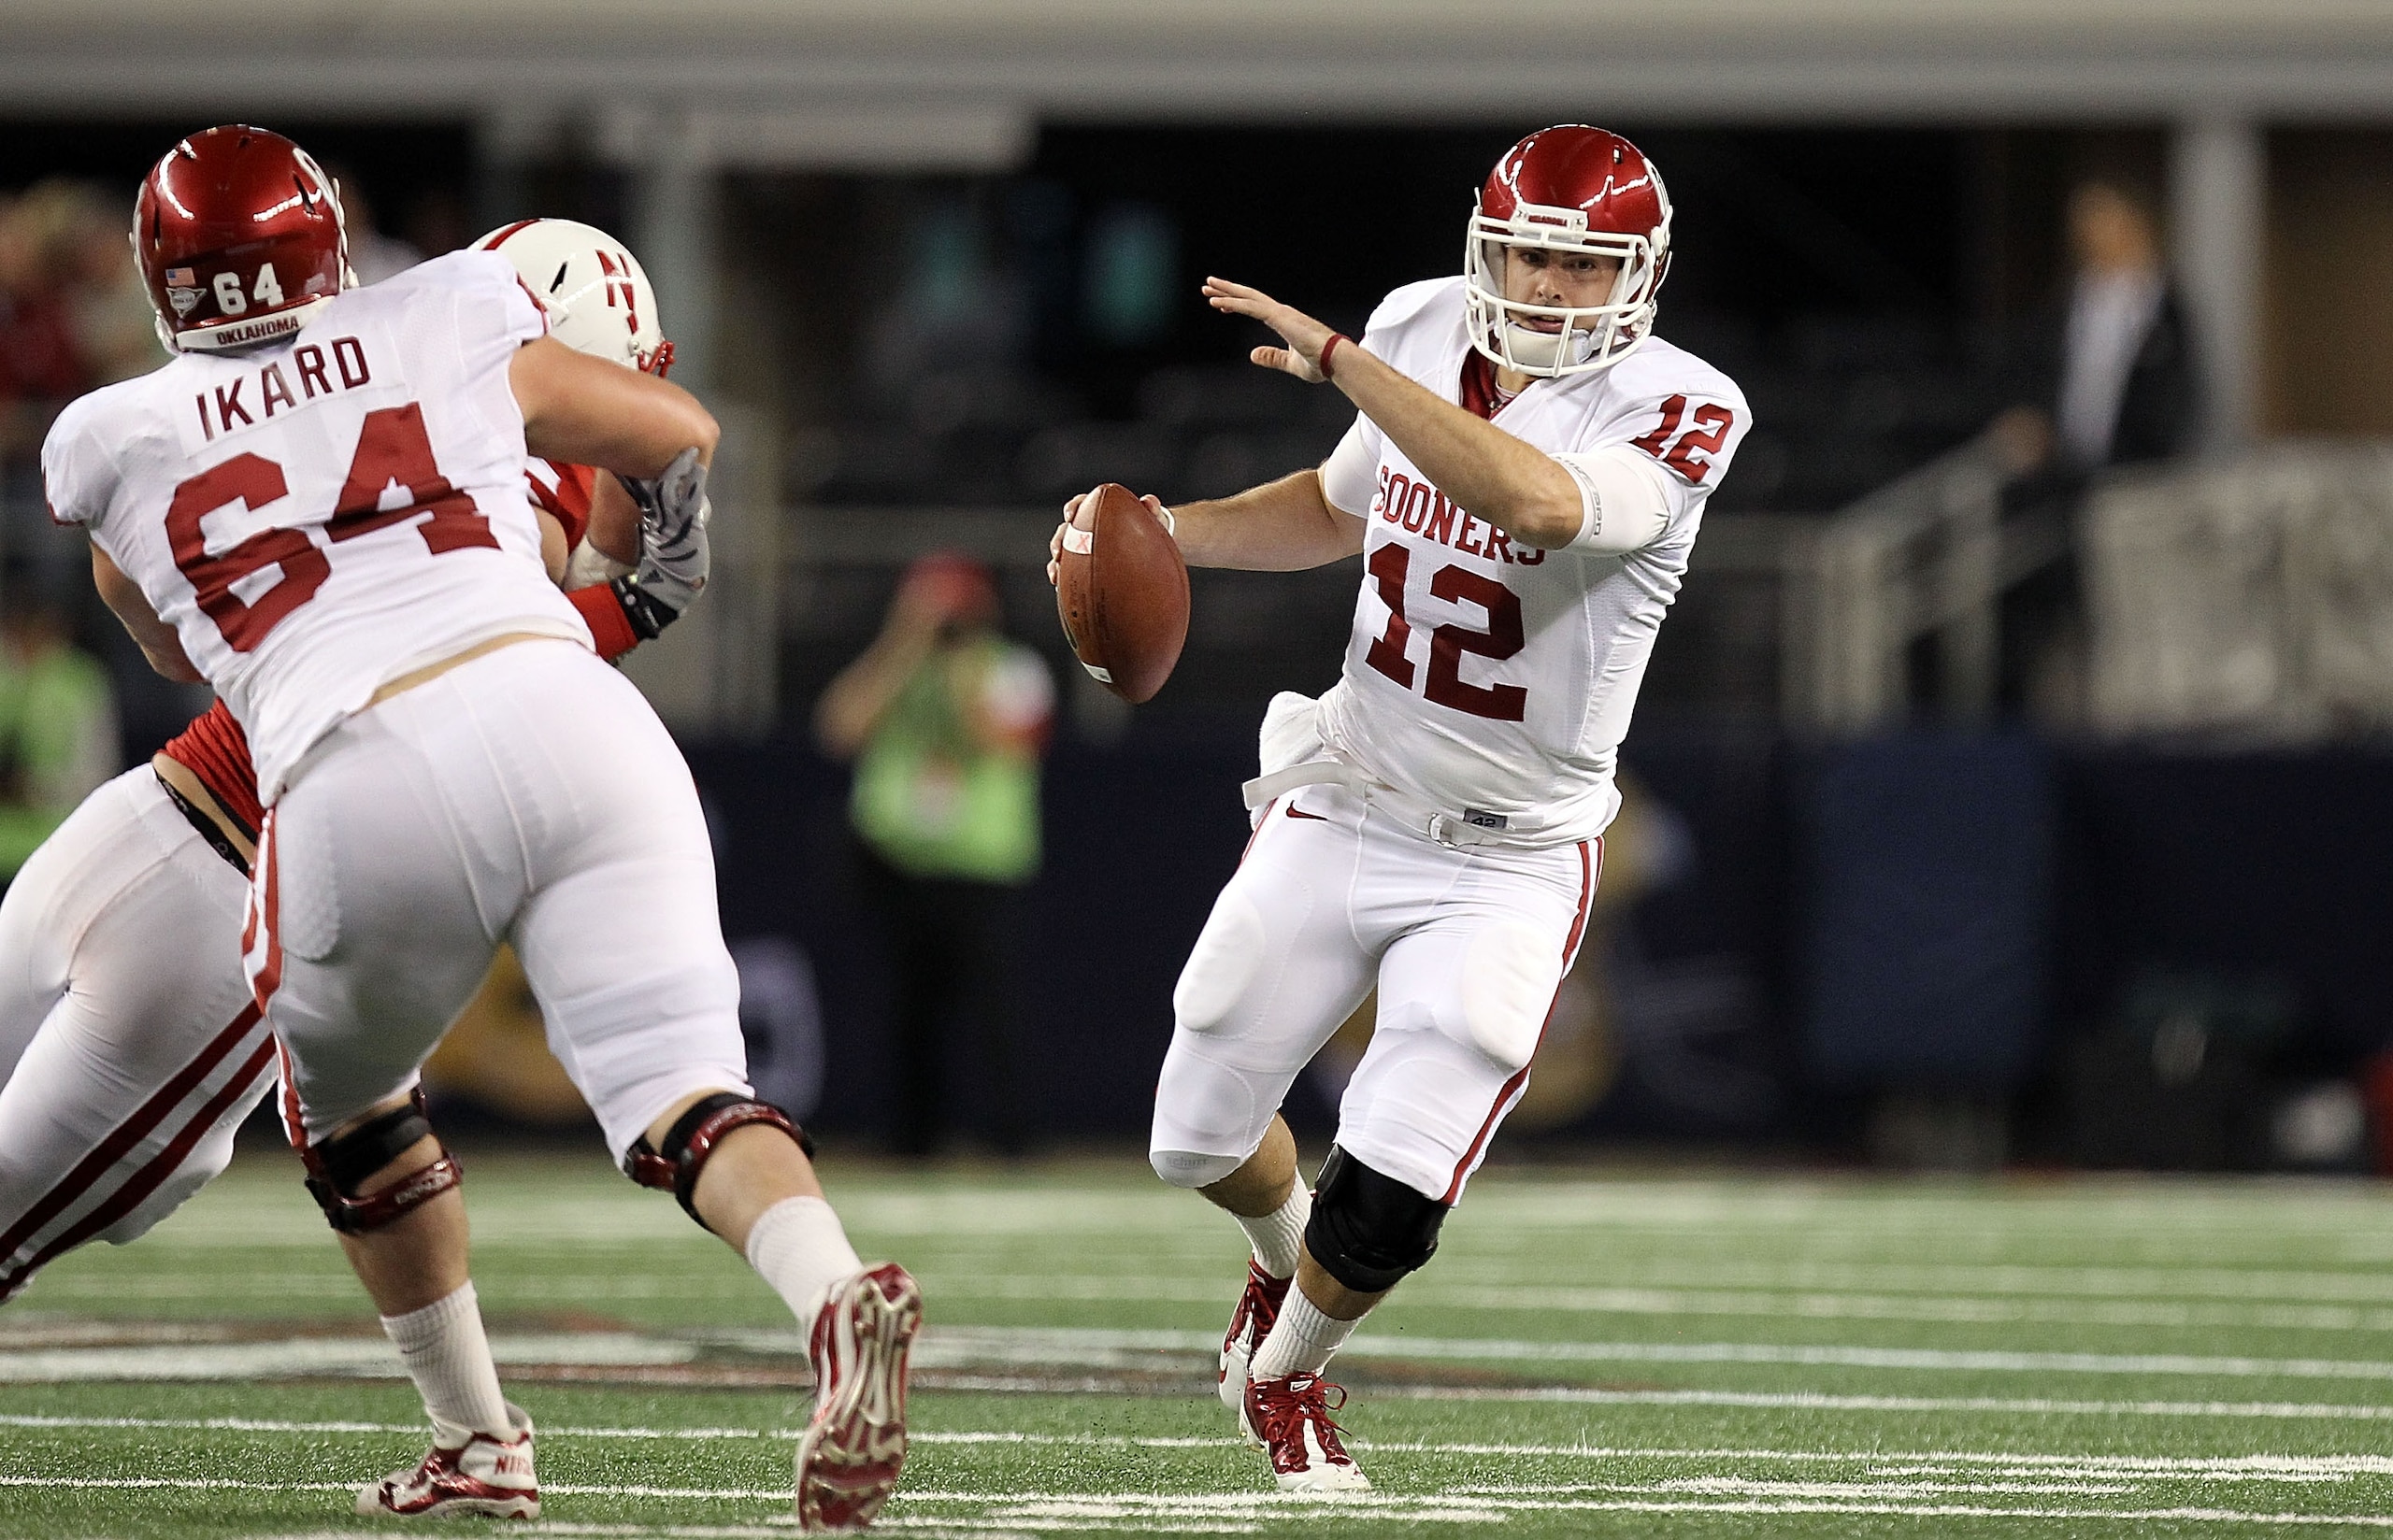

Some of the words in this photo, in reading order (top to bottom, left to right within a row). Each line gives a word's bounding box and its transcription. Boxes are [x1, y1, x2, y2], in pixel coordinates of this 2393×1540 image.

[213, 263, 284, 315] 64
[216, 316, 299, 346] OKLAHOMA
[196, 335, 372, 443] IKARD
[1628, 393, 1733, 484] 12
[165, 401, 503, 653] 64
[1374, 465, 1546, 566] SOONER
[1365, 541, 1527, 722] 12
[1471, 816, 1497, 828] 42
